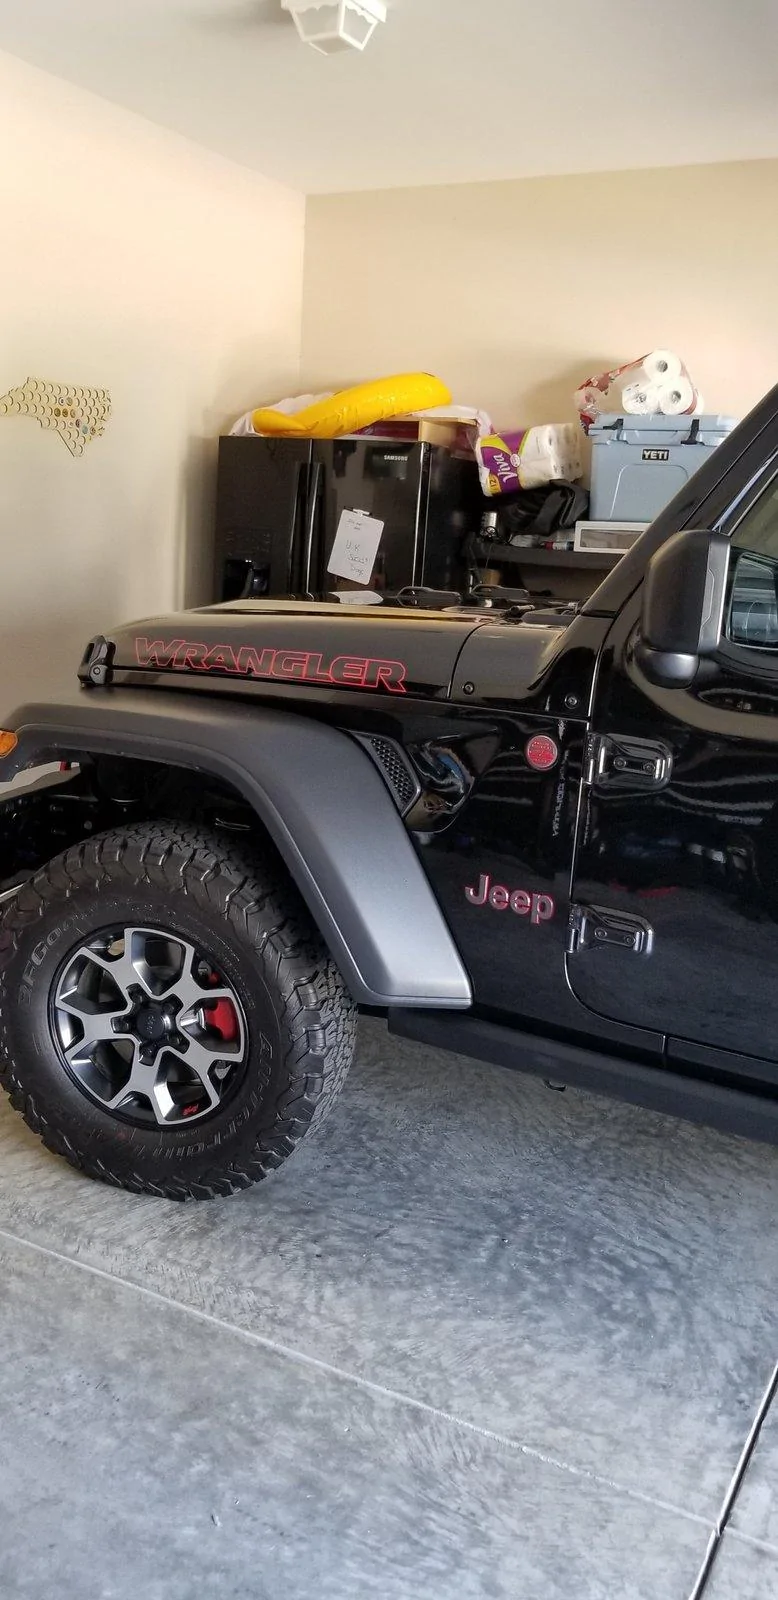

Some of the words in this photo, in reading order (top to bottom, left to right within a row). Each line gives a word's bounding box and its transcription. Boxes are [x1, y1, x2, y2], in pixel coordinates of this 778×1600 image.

[493, 453, 518, 483] Viva
[643, 450, 668, 460] YETI
[135, 637, 407, 693] WRANGLER
[464, 873, 556, 925] Jeep
